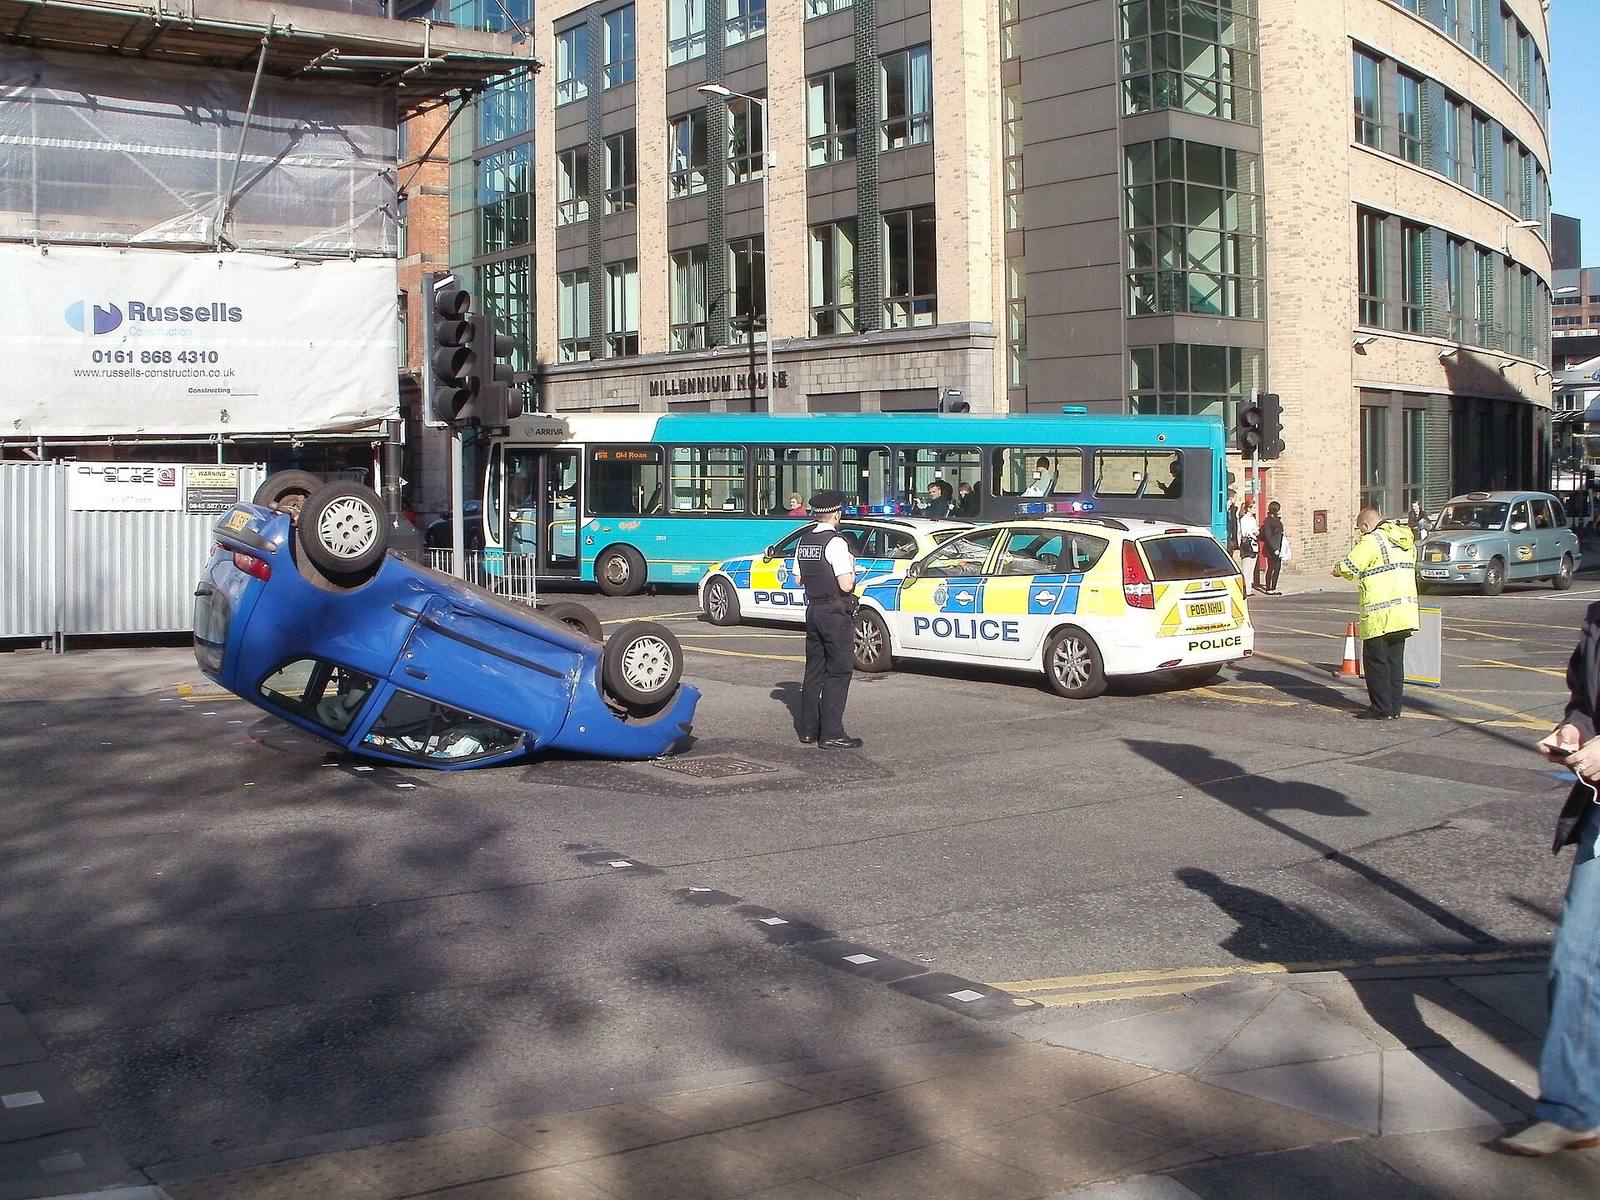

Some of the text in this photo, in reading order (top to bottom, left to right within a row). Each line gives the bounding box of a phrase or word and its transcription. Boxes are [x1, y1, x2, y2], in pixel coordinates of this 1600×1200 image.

[128, 301, 243, 323] Russells
[92, 350, 219, 364] 0161 868 4310
[73, 367, 235, 378] www.russells-construction.co.uk
[188, 387, 231, 395] Constructing
[649, 375, 732, 397] MILLENNIUM
[535, 428, 564, 436] ARRIVA
[799, 547, 820, 558] POLICE
[754, 591, 809, 607] POLI
[913, 616, 1020, 642] POLICE
[1188, 636, 1241, 651] POLICE
